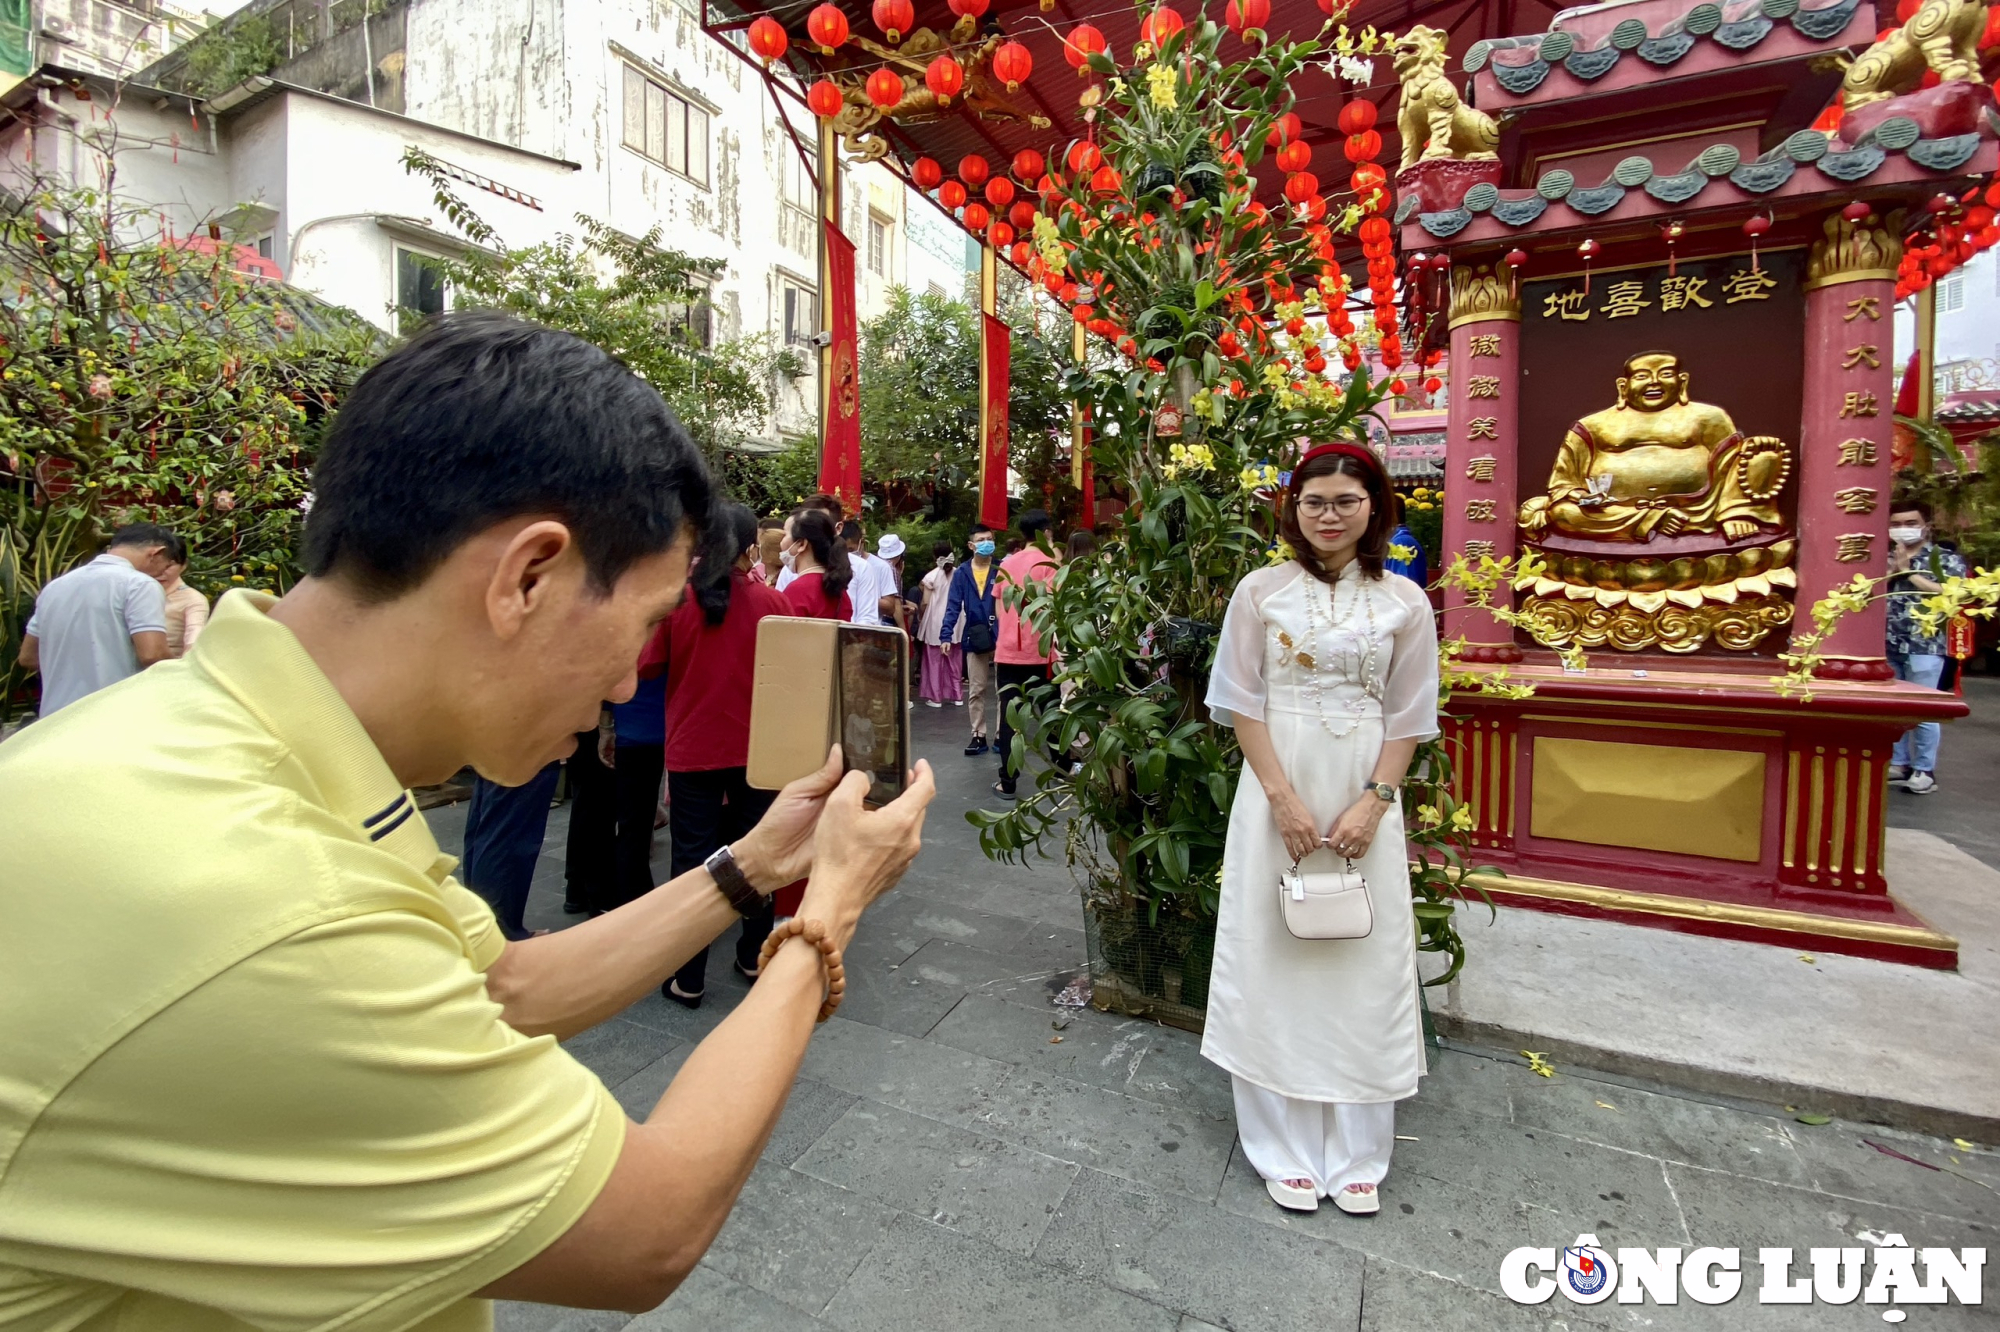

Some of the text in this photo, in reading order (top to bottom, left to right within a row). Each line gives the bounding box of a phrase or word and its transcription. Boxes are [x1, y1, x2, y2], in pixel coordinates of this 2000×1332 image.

[1834, 294, 1881, 603] 大大肚能容萬
